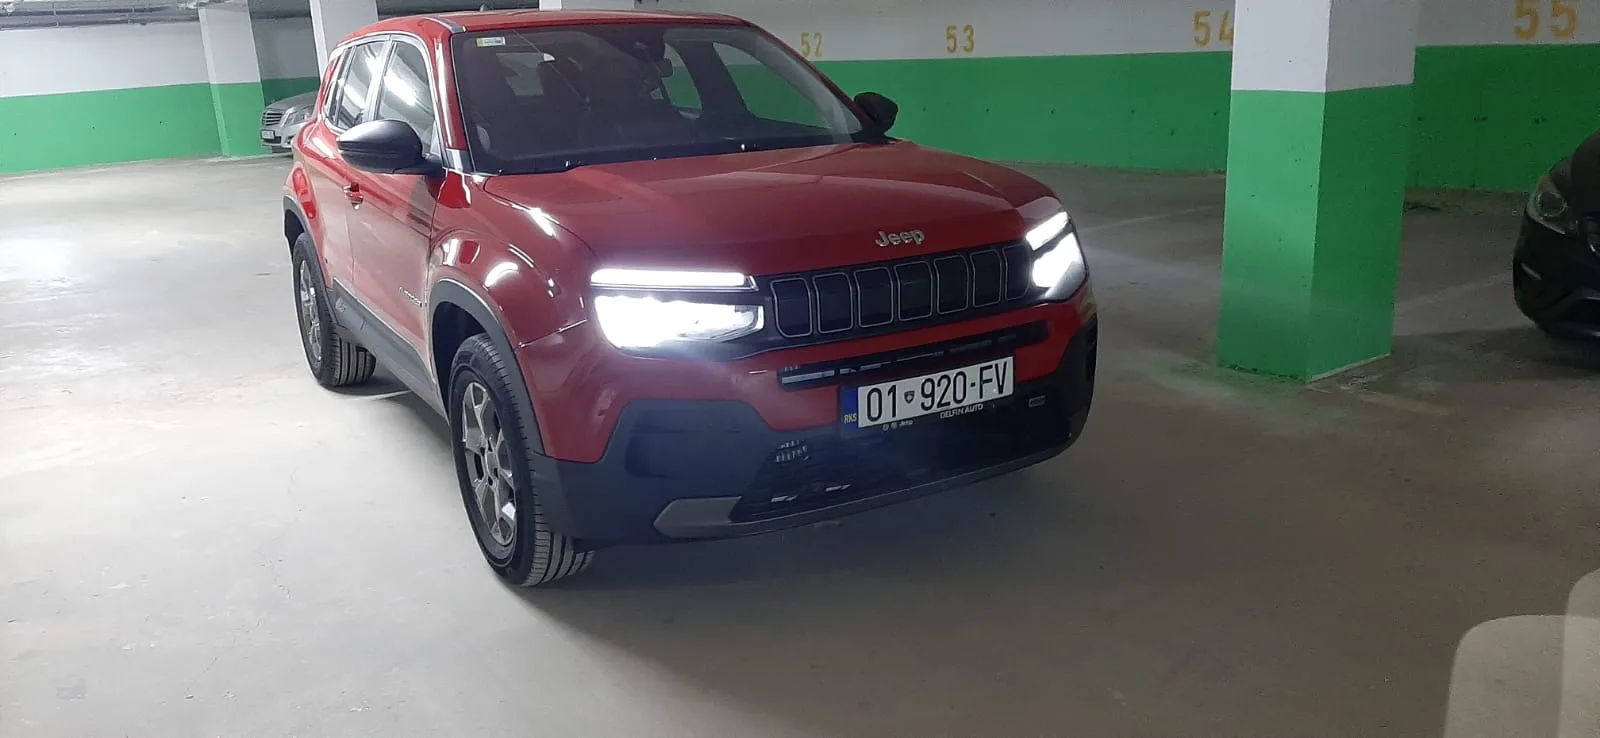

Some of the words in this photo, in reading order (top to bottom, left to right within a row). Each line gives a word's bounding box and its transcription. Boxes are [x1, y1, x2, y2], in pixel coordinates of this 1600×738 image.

[1193, 10, 1234, 47] 54
[1514, 0, 1577, 39] 55
[800, 32, 822, 57] 52
[946, 24, 975, 53] 53
[875, 230, 925, 247] Jeep
[867, 385, 897, 422] 01
[940, 408, 965, 419] DELFIN
[965, 403, 984, 414] AUTO
[844, 413, 857, 424] RKS
